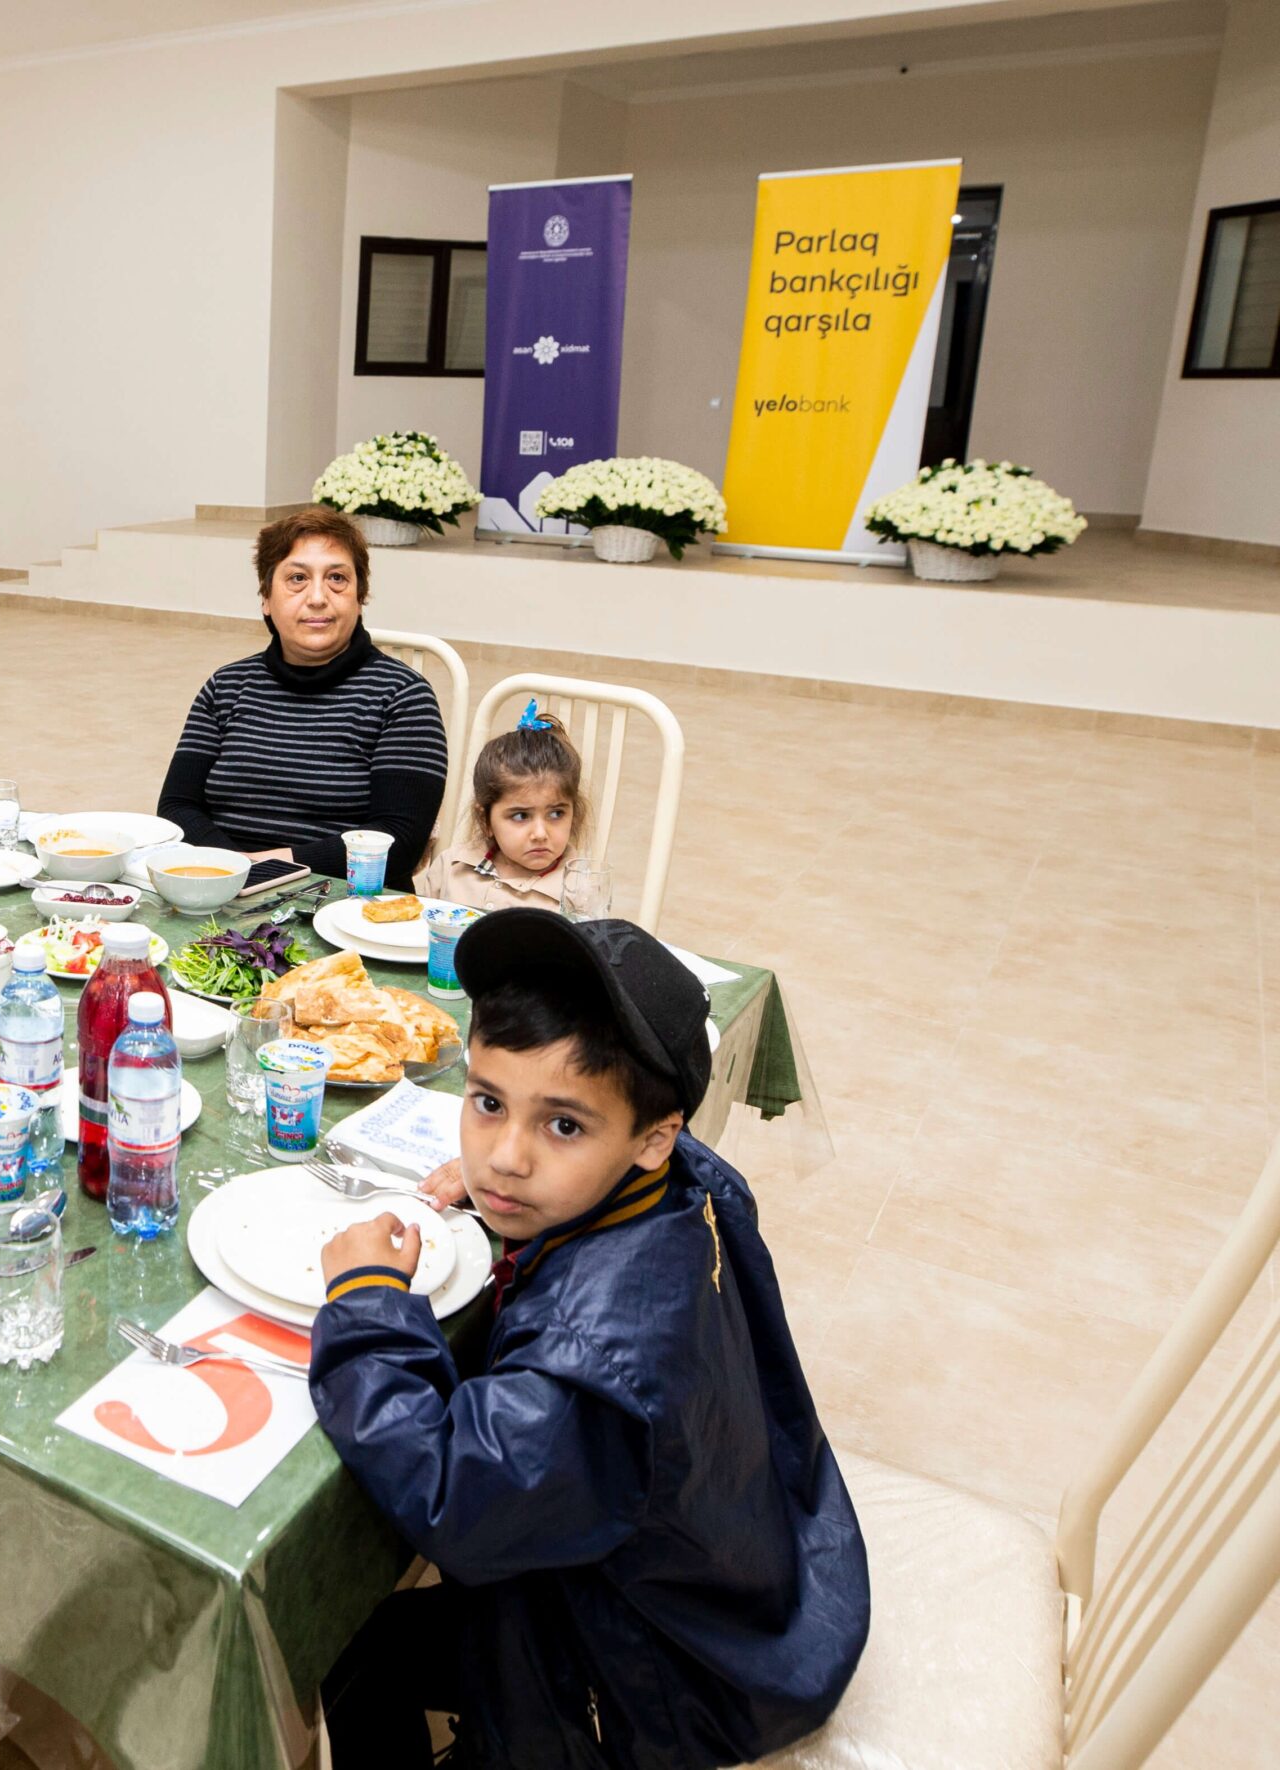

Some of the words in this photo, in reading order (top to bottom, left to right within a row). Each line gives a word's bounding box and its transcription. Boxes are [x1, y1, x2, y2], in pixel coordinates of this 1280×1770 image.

[774, 228, 880, 257] Parlaq
[769, 263, 920, 300] bankçılığı
[764, 307, 872, 340] qarşıla
[754, 394, 851, 417] yelobank
